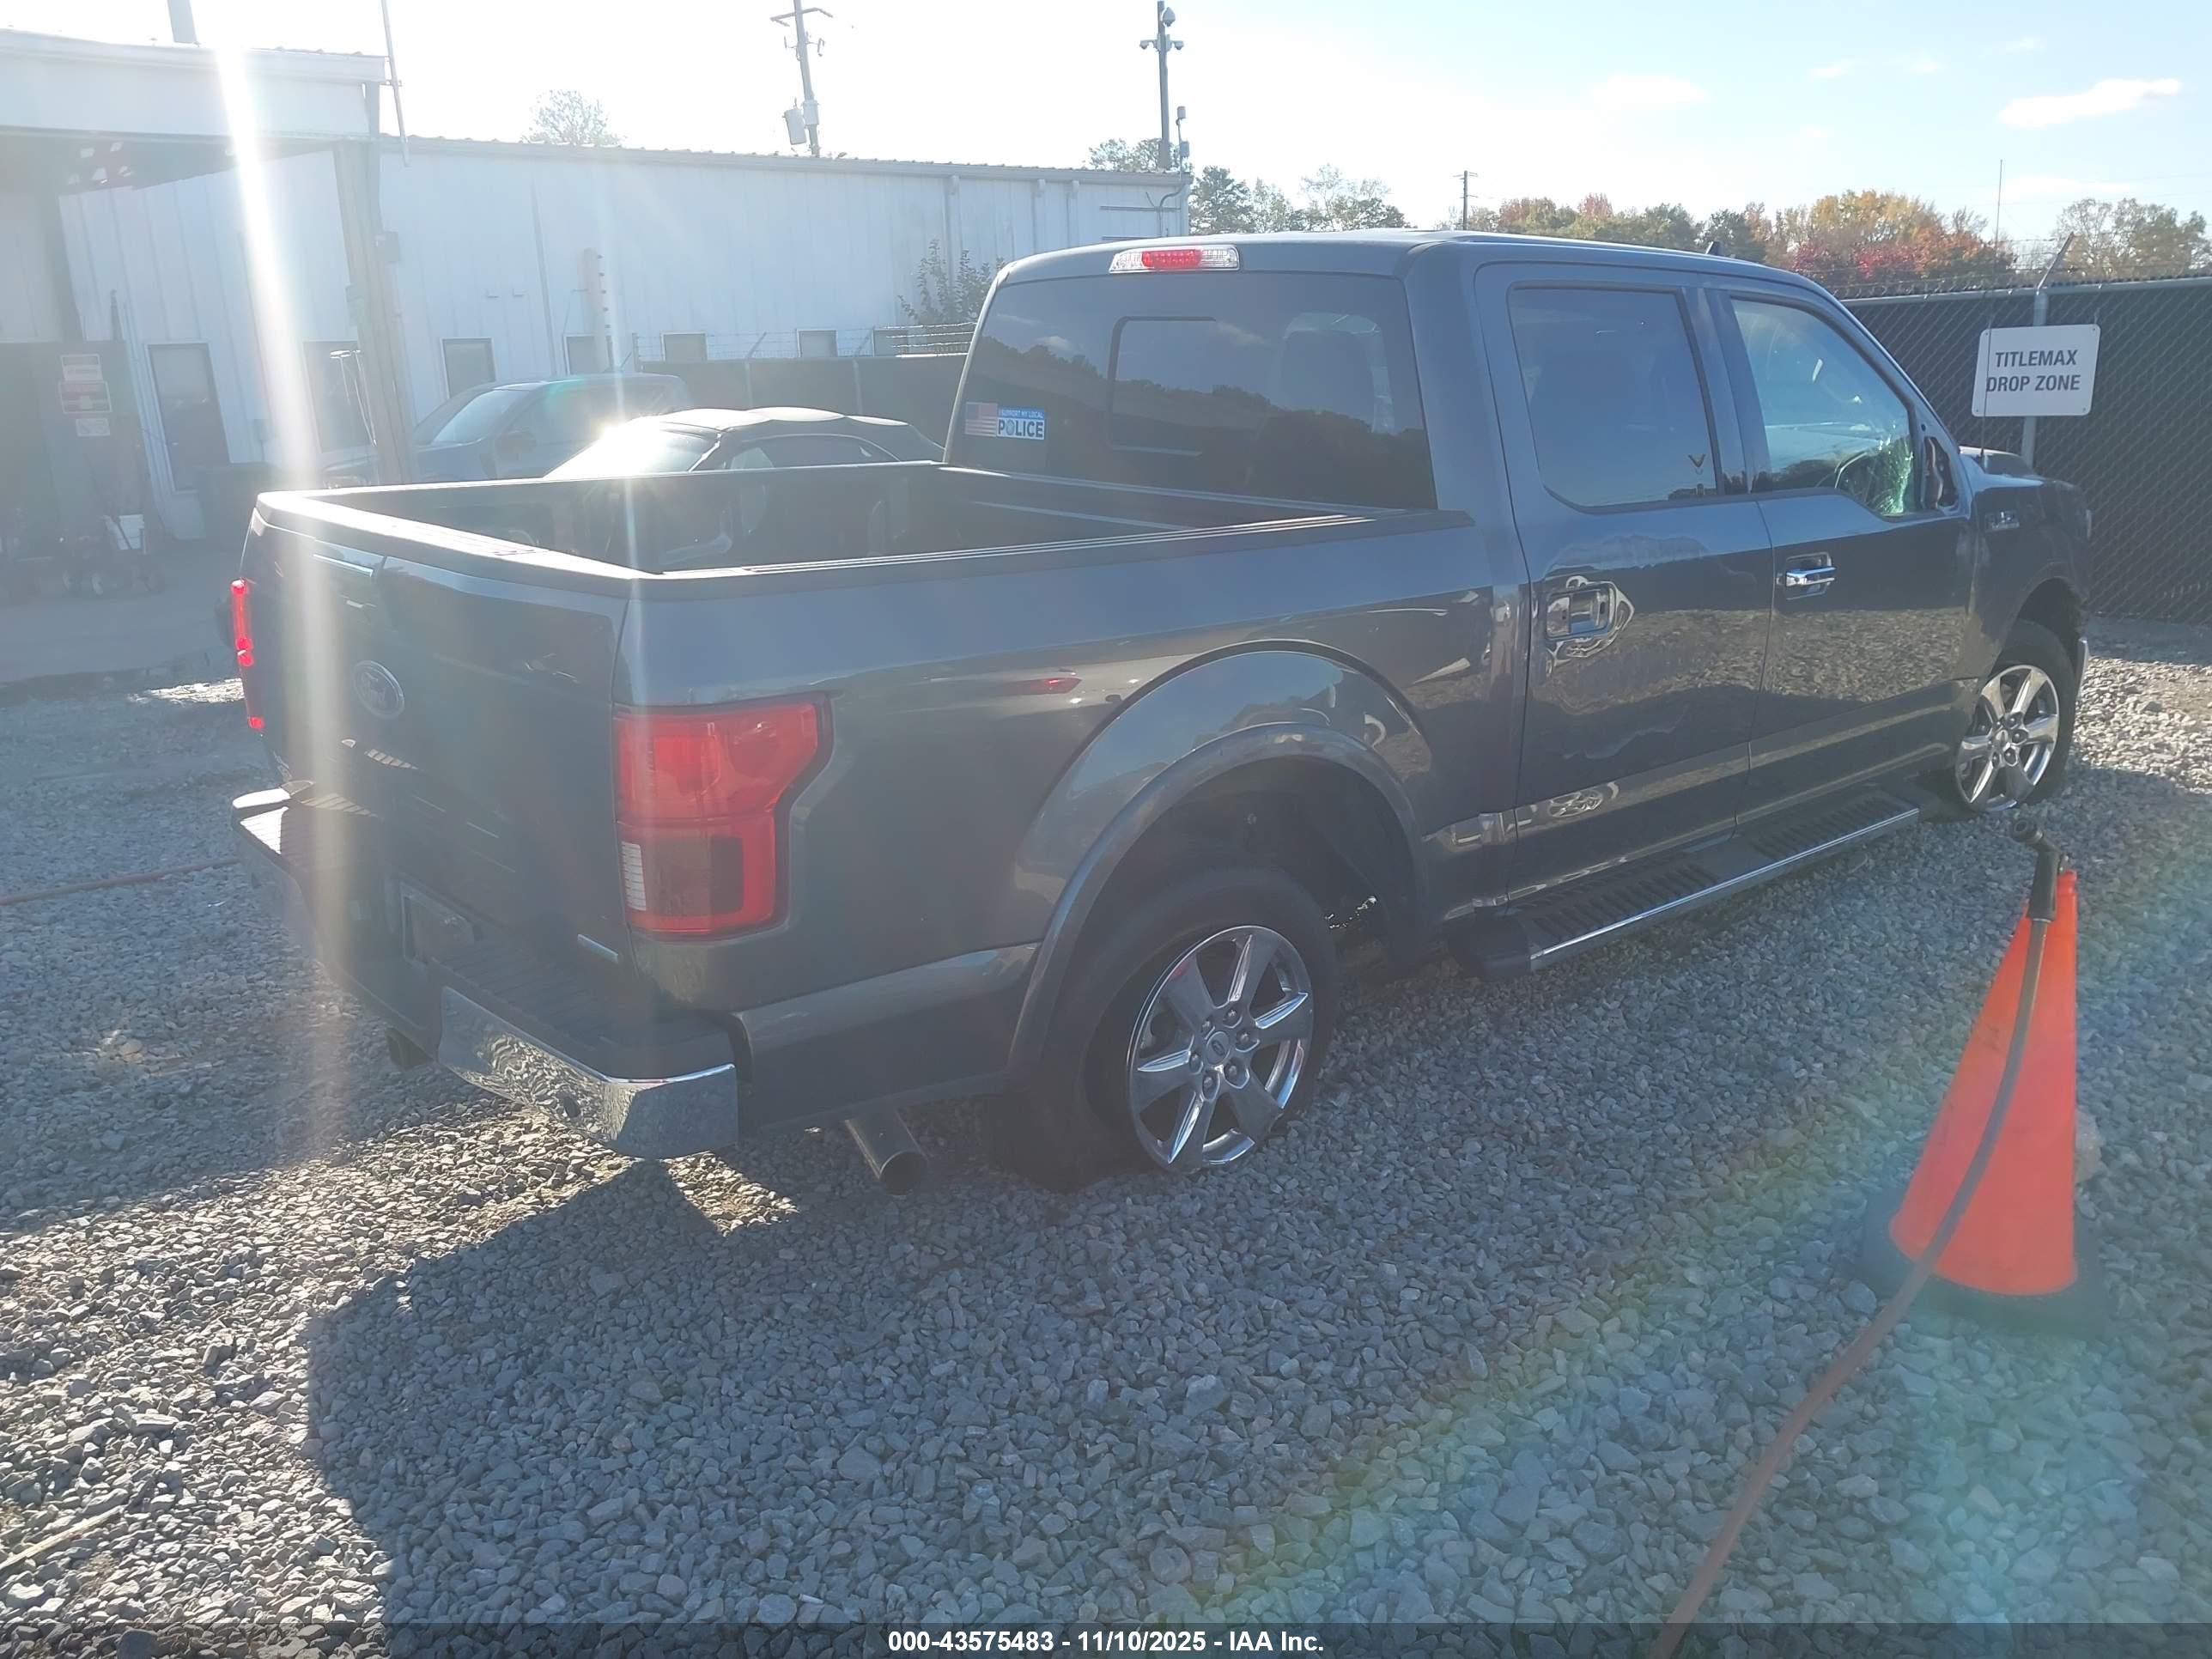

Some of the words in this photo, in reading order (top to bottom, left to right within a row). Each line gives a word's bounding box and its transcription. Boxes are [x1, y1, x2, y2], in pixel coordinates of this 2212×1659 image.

[1995, 349, 2078, 368] TITLEMAX
[1985, 375, 2031, 392] DROP
[2034, 374, 2081, 392] ZONE
[998, 419, 1043, 437] POLICE
